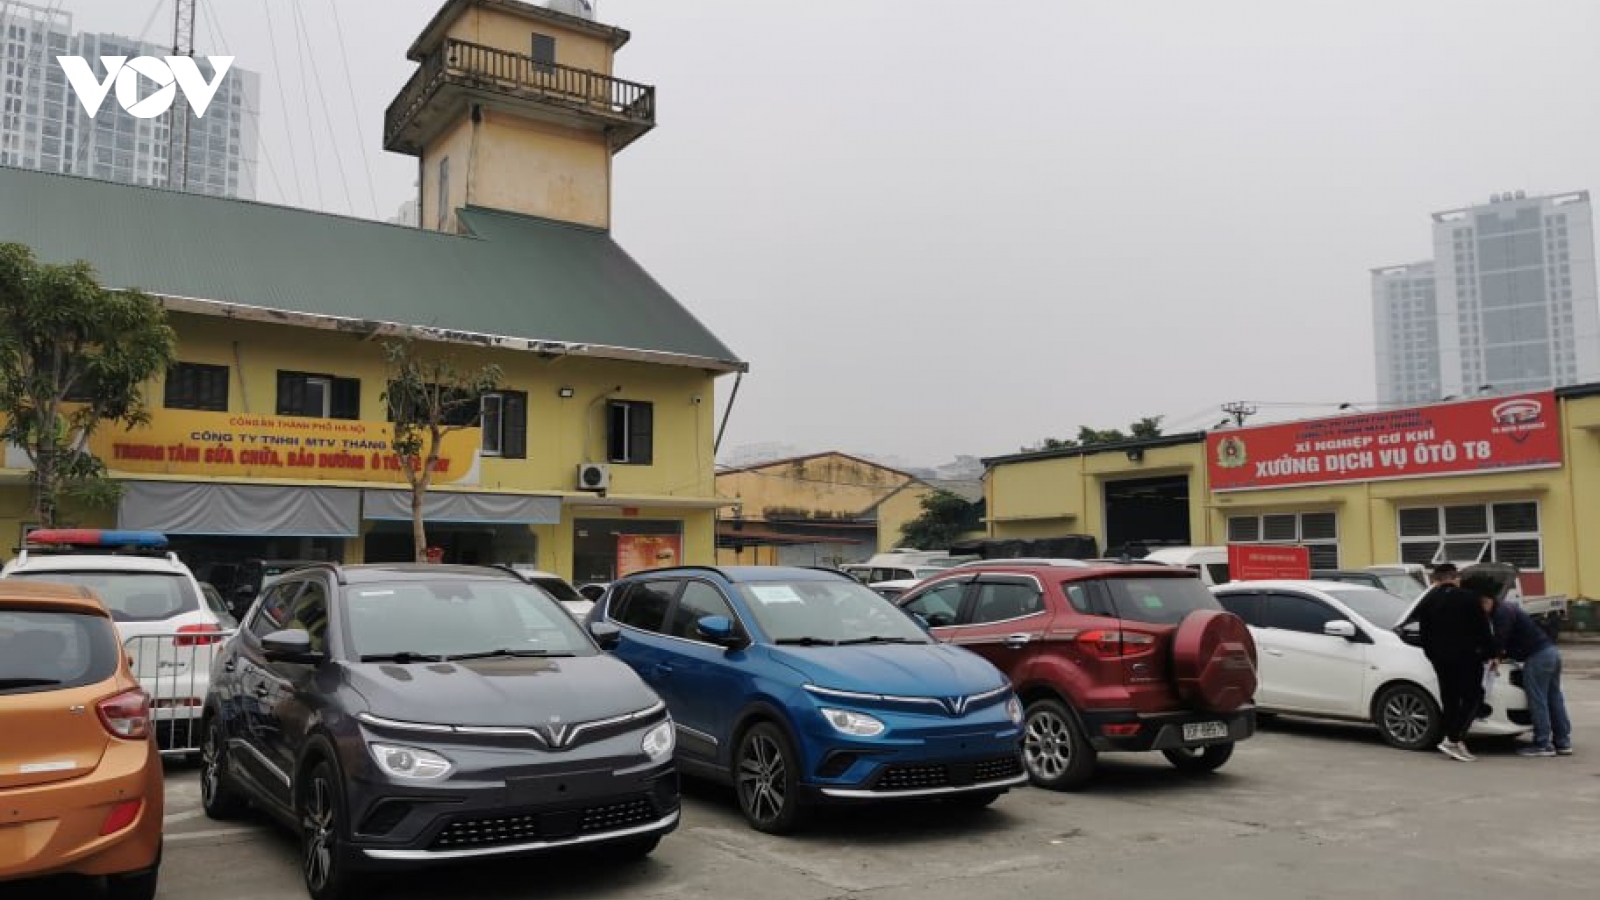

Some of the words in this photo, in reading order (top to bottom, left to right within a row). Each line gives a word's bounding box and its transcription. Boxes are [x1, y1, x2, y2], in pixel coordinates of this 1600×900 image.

[191, 430, 233, 442] CÔNG
[238, 434, 258, 443] TY
[261, 435, 299, 446] TNHH
[305, 437, 335, 448] MTV
[1315, 436, 1373, 452] NGHIỆP
[1405, 427, 1436, 442] KHÍ
[1256, 453, 1320, 478] XƯỞNG
[1326, 451, 1374, 473] DỊCH
[1379, 447, 1408, 470] VỤ
[1414, 439, 1457, 464] ÔTÔ
[1462, 440, 1492, 461] T8
